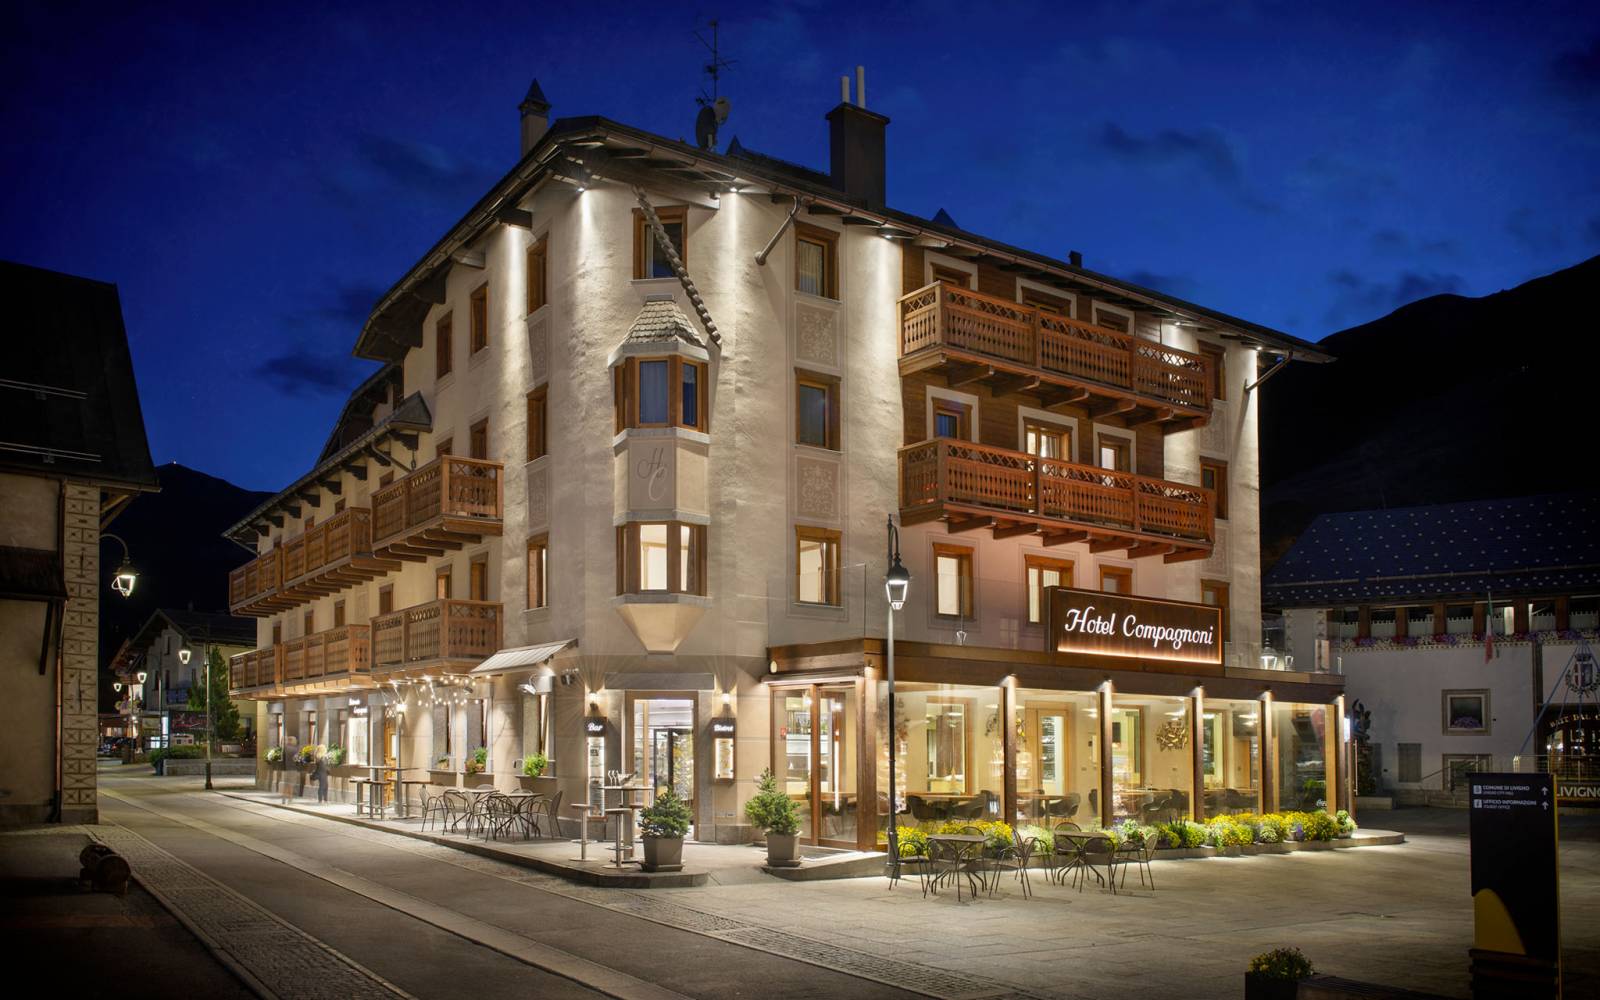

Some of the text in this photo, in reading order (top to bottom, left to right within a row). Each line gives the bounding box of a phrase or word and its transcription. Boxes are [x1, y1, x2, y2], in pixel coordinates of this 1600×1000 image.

[1064, 606, 1214, 650] Hotel Compagnoni
[587, 722, 604, 731] Bar
[1556, 786, 1600, 798] IVIGN
